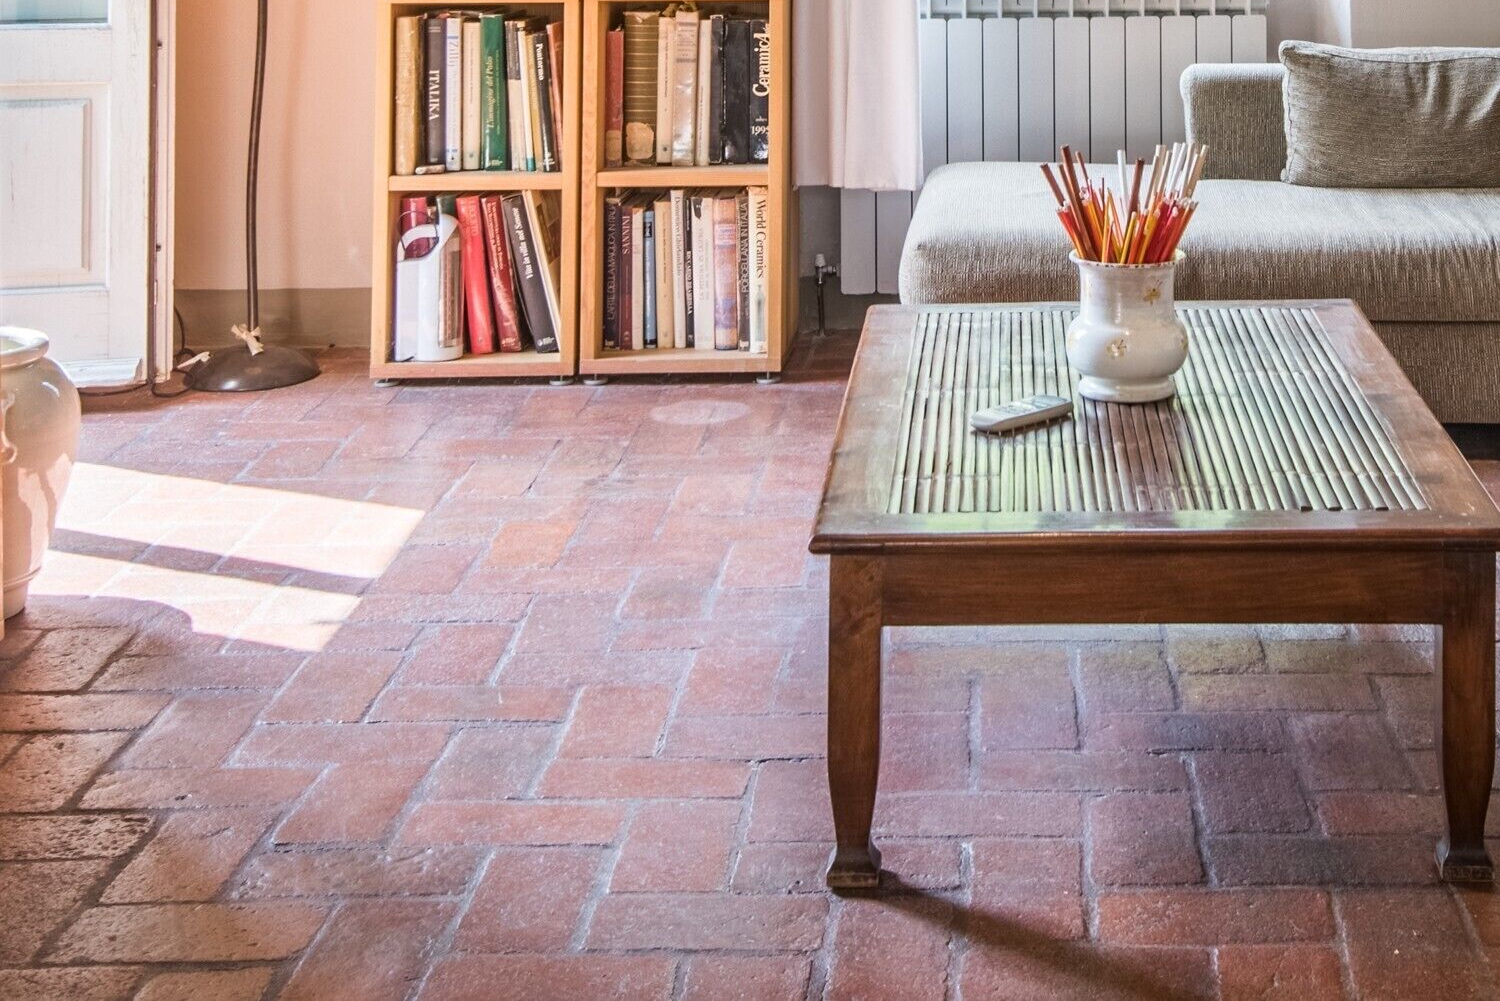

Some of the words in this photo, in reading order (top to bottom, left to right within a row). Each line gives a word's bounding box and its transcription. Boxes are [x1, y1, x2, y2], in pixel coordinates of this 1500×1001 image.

[535, 43, 544, 81] Pontormo
[429, 69, 440, 121] ITALIKA
[622, 215, 631, 255] SANNINI
[756, 200, 767, 229] World
[740, 238, 749, 293] PORCELLANA
[756, 231, 767, 278] Ceramics
